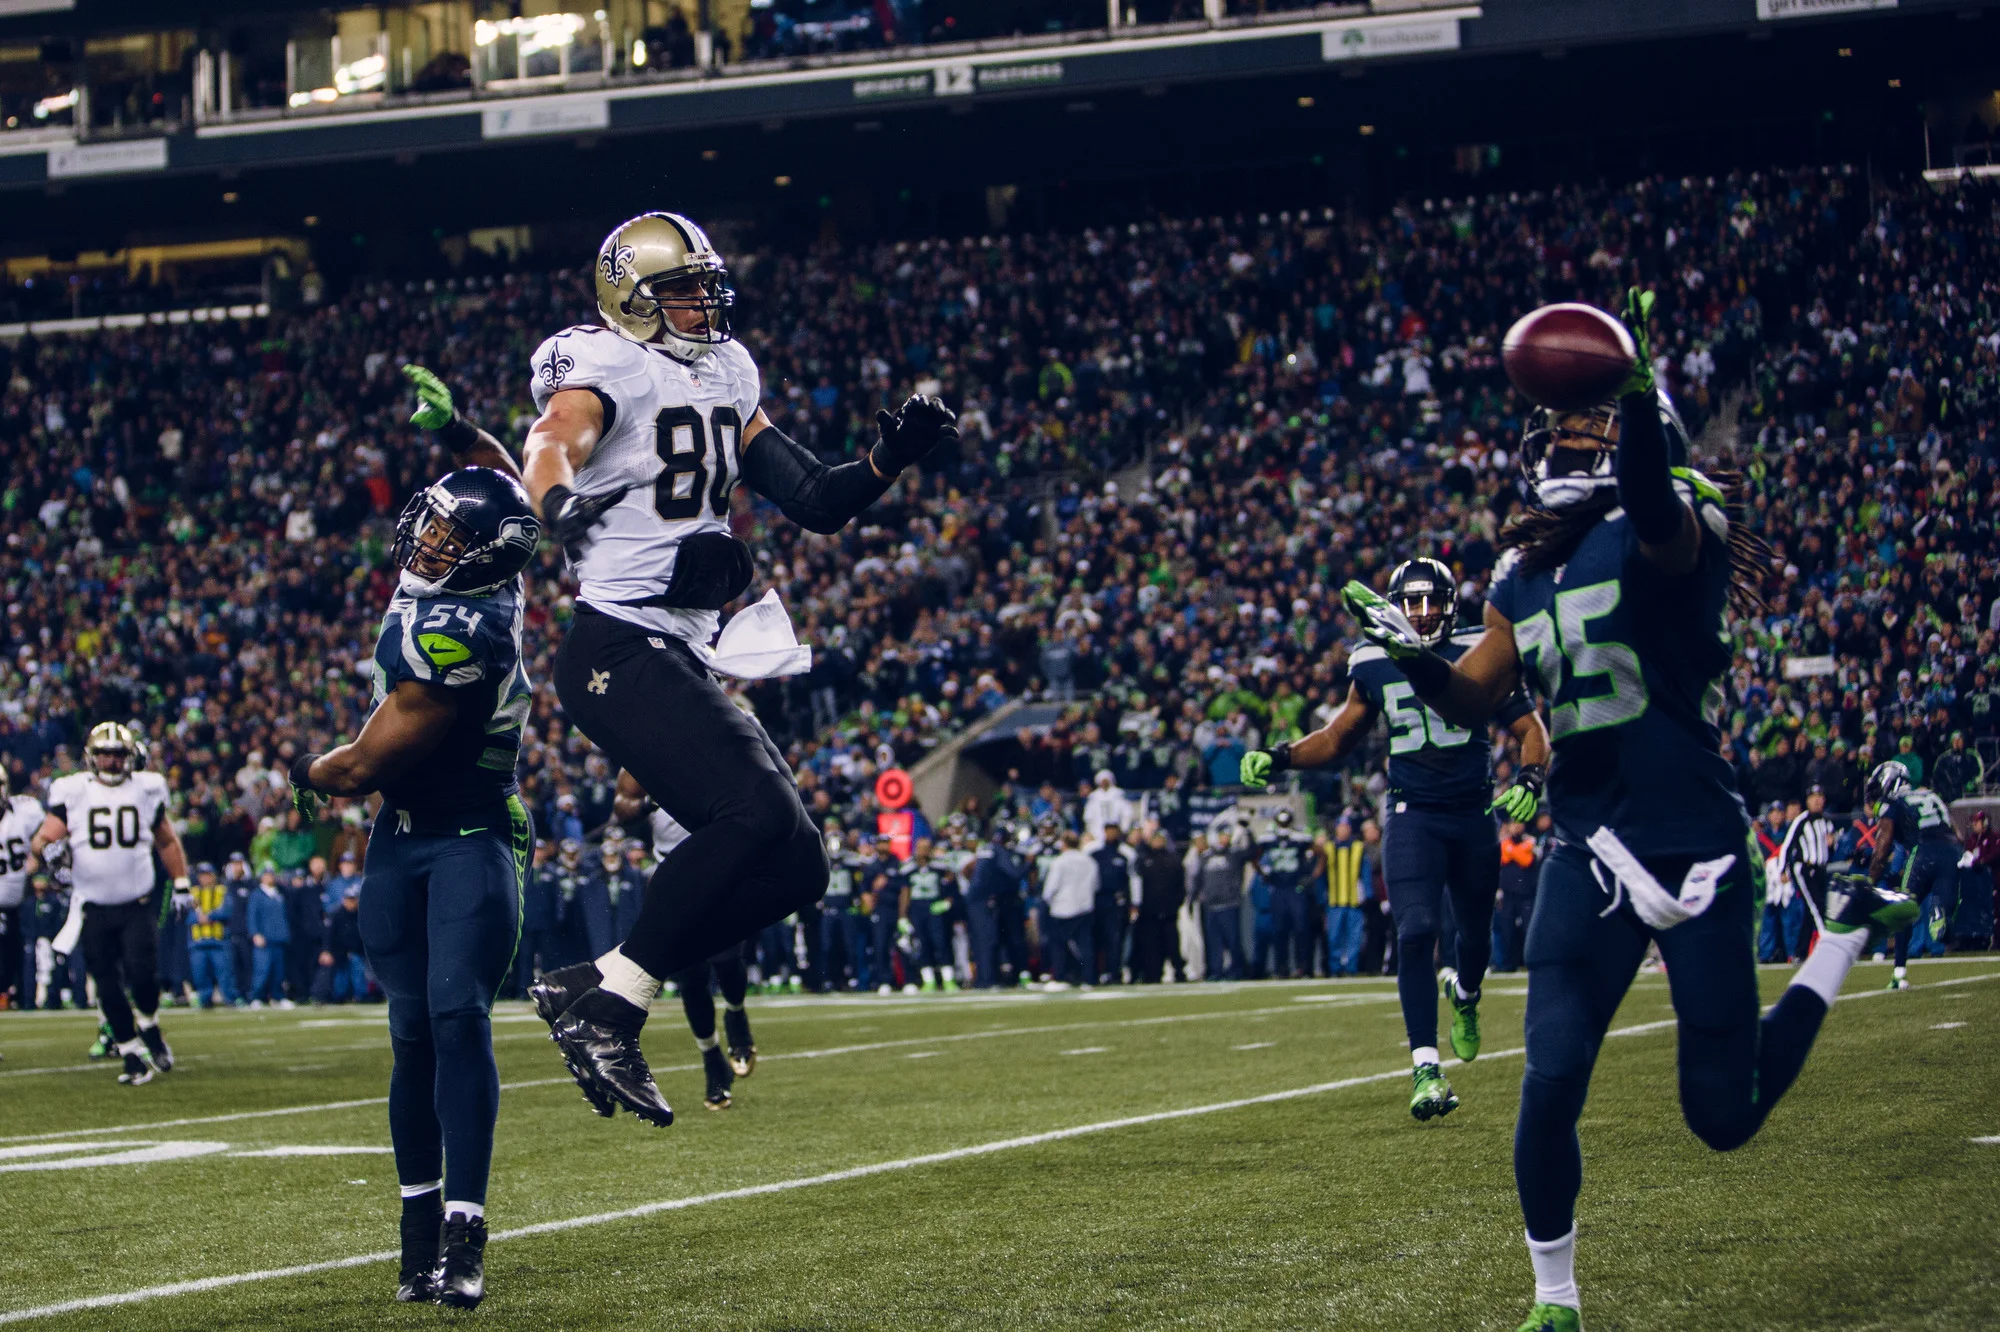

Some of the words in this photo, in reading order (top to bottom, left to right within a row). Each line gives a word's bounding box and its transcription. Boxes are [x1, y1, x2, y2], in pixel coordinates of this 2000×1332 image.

[933, 65, 974, 96] 12
[653, 404, 743, 522] 80
[423, 604, 483, 637] 54
[88, 805, 139, 849] 60
